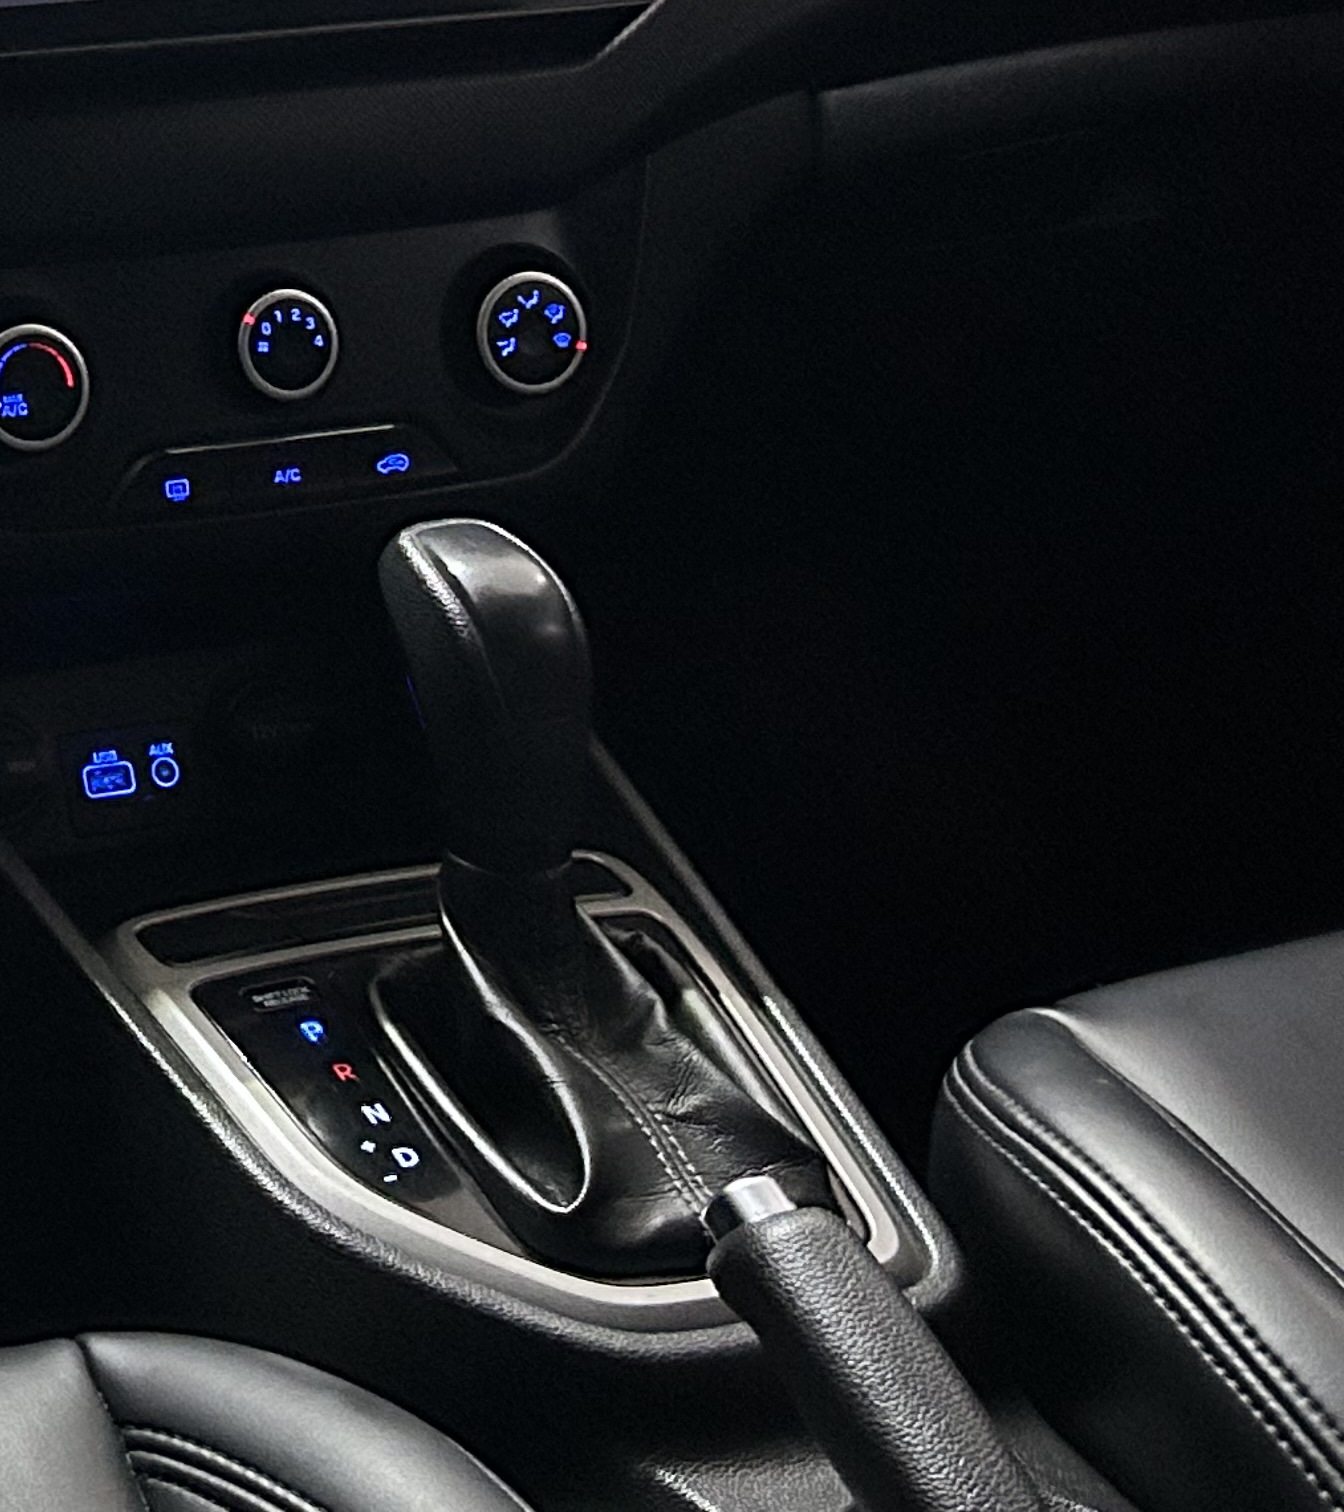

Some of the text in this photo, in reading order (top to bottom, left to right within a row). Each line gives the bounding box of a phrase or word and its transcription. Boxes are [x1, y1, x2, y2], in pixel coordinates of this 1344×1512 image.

[291, 308, 301, 321] 2
[305, 317, 316, 330] 3
[314, 335, 325, 347] 4
[274, 468, 301, 483] A/C
[300, 1021, 323, 1042] P
[332, 1063, 359, 1082] R
[361, 1103, 390, 1124] N
[392, 1147, 419, 1167] D
